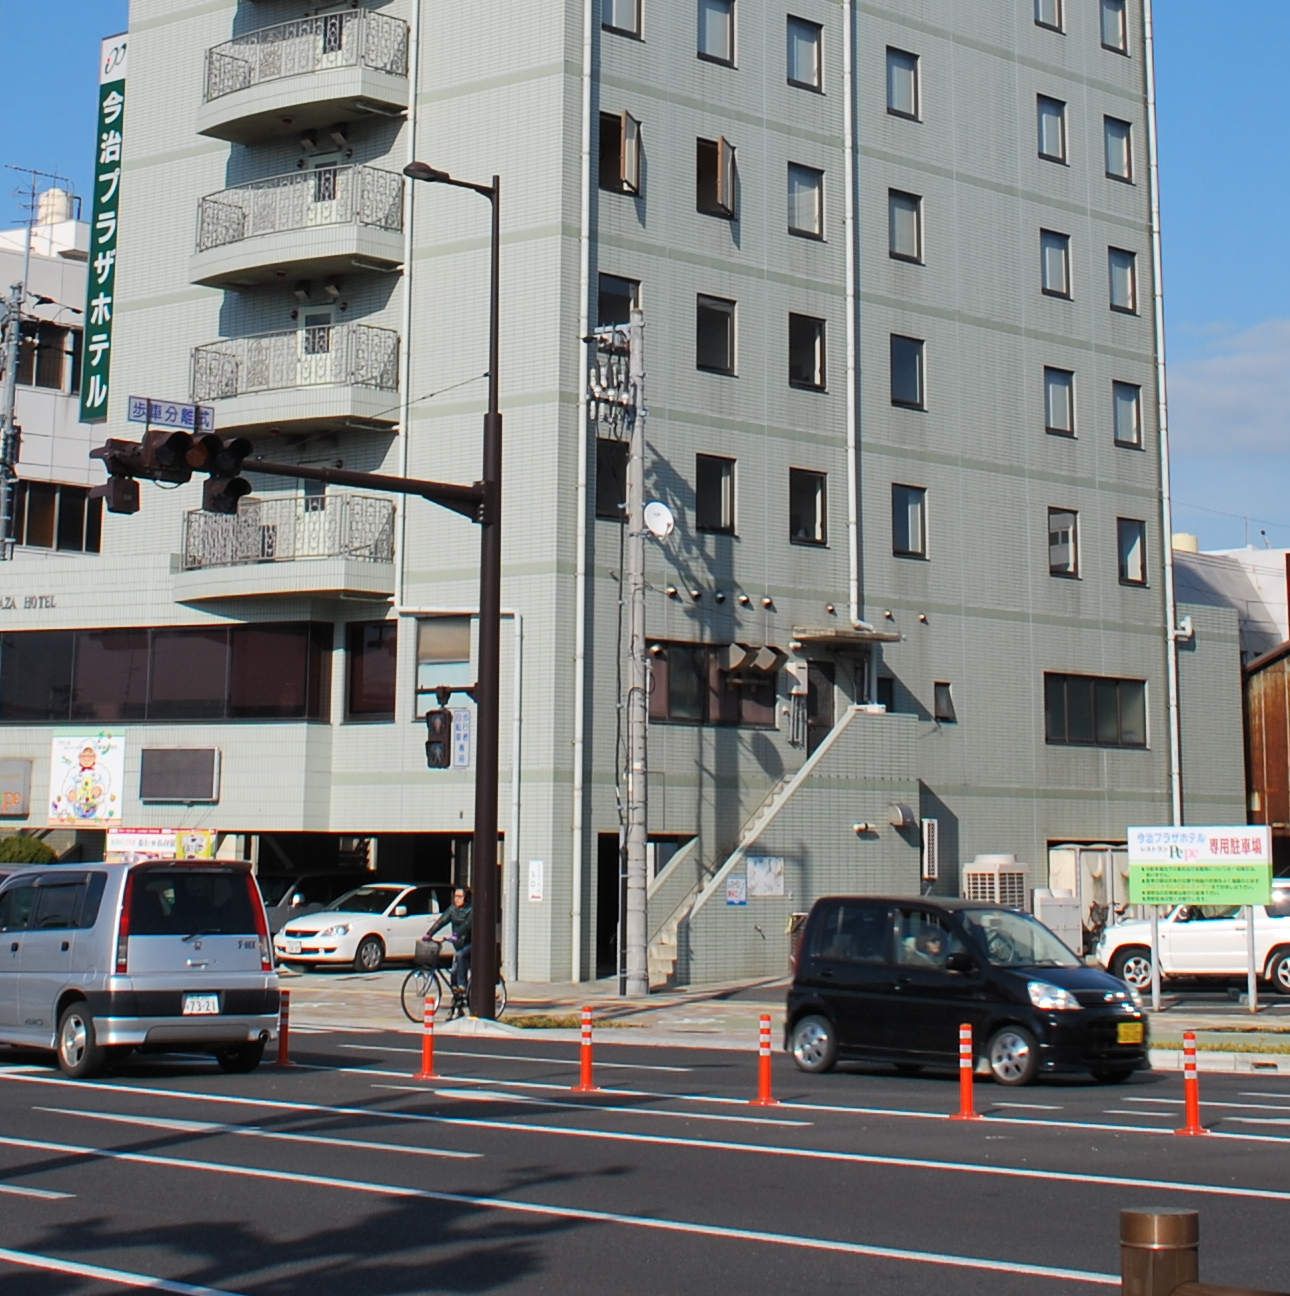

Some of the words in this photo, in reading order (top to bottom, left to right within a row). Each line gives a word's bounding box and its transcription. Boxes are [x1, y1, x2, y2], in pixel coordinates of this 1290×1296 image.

[86, 90, 125, 409] 今治プラザホテル
[24, 595, 57, 609] HOTEL
[1137, 832, 1206, 844] 今治プラザホテル
[1209, 838, 1262, 855] 専用駐車場
[190, 1001, 216, 1012] 73-21
